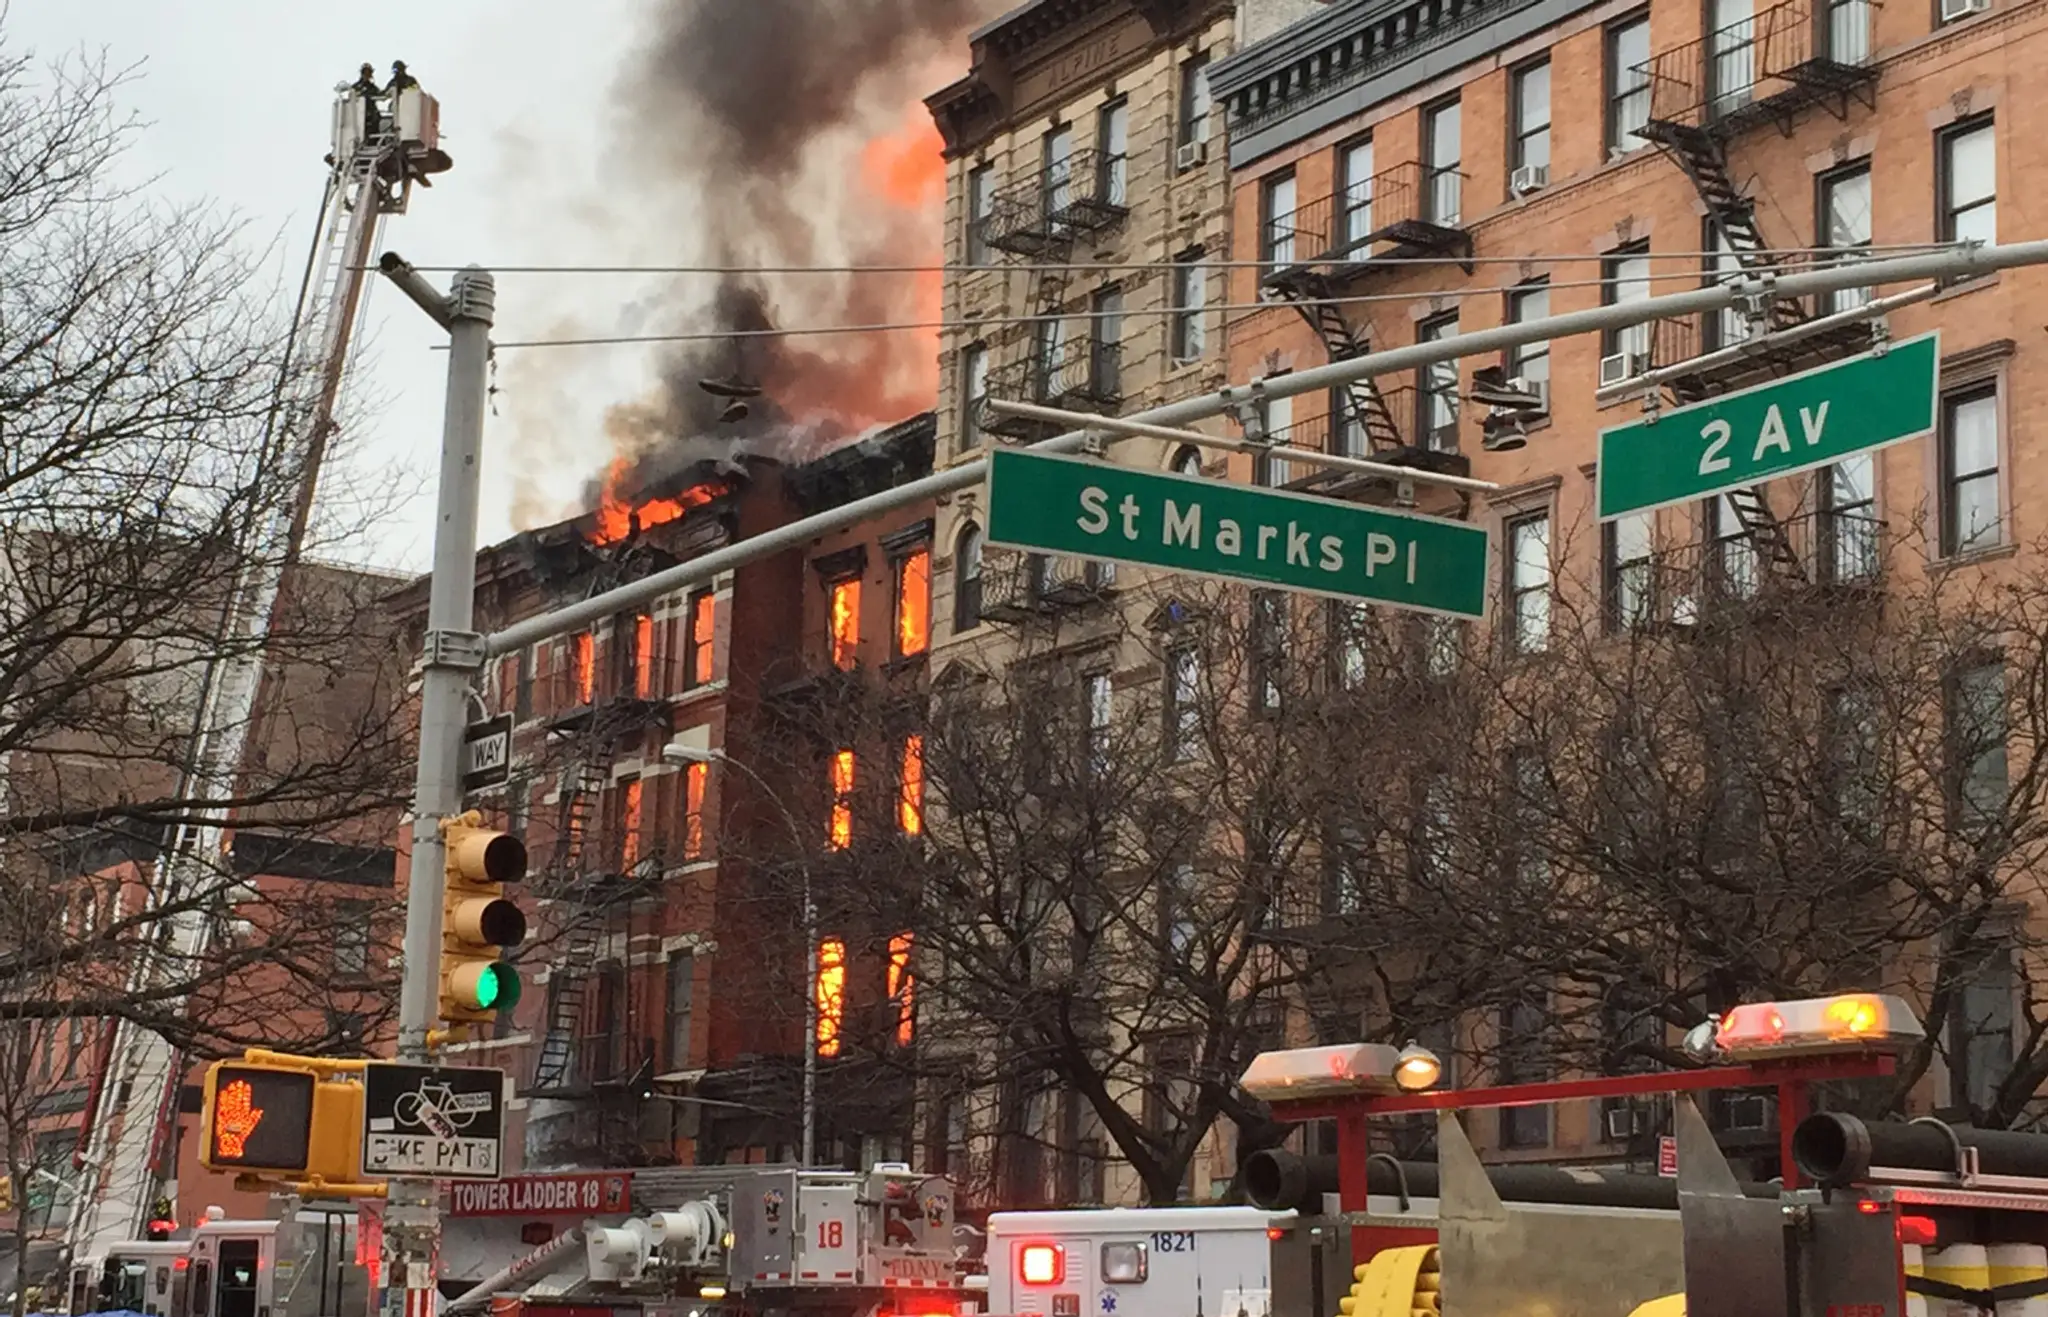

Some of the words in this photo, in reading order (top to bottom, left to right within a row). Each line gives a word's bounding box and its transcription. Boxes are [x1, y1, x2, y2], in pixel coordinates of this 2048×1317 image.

[1048, 33, 1120, 89] ALPINE
[1699, 419, 1731, 475] 2
[1752, 400, 1830, 461] Av
[1076, 486, 1140, 541] St
[1162, 498, 1343, 572] Marks
[1366, 531, 1417, 584] Pl
[474, 736, 504, 769] WAY
[436, 1142, 491, 1167] PAT
[454, 1182, 509, 1211] TOWER
[513, 1181, 577, 1209] LADDER
[582, 1180, 599, 1208] 18
[818, 1221, 842, 1248] 18
[1150, 1231, 1195, 1253] 1821
